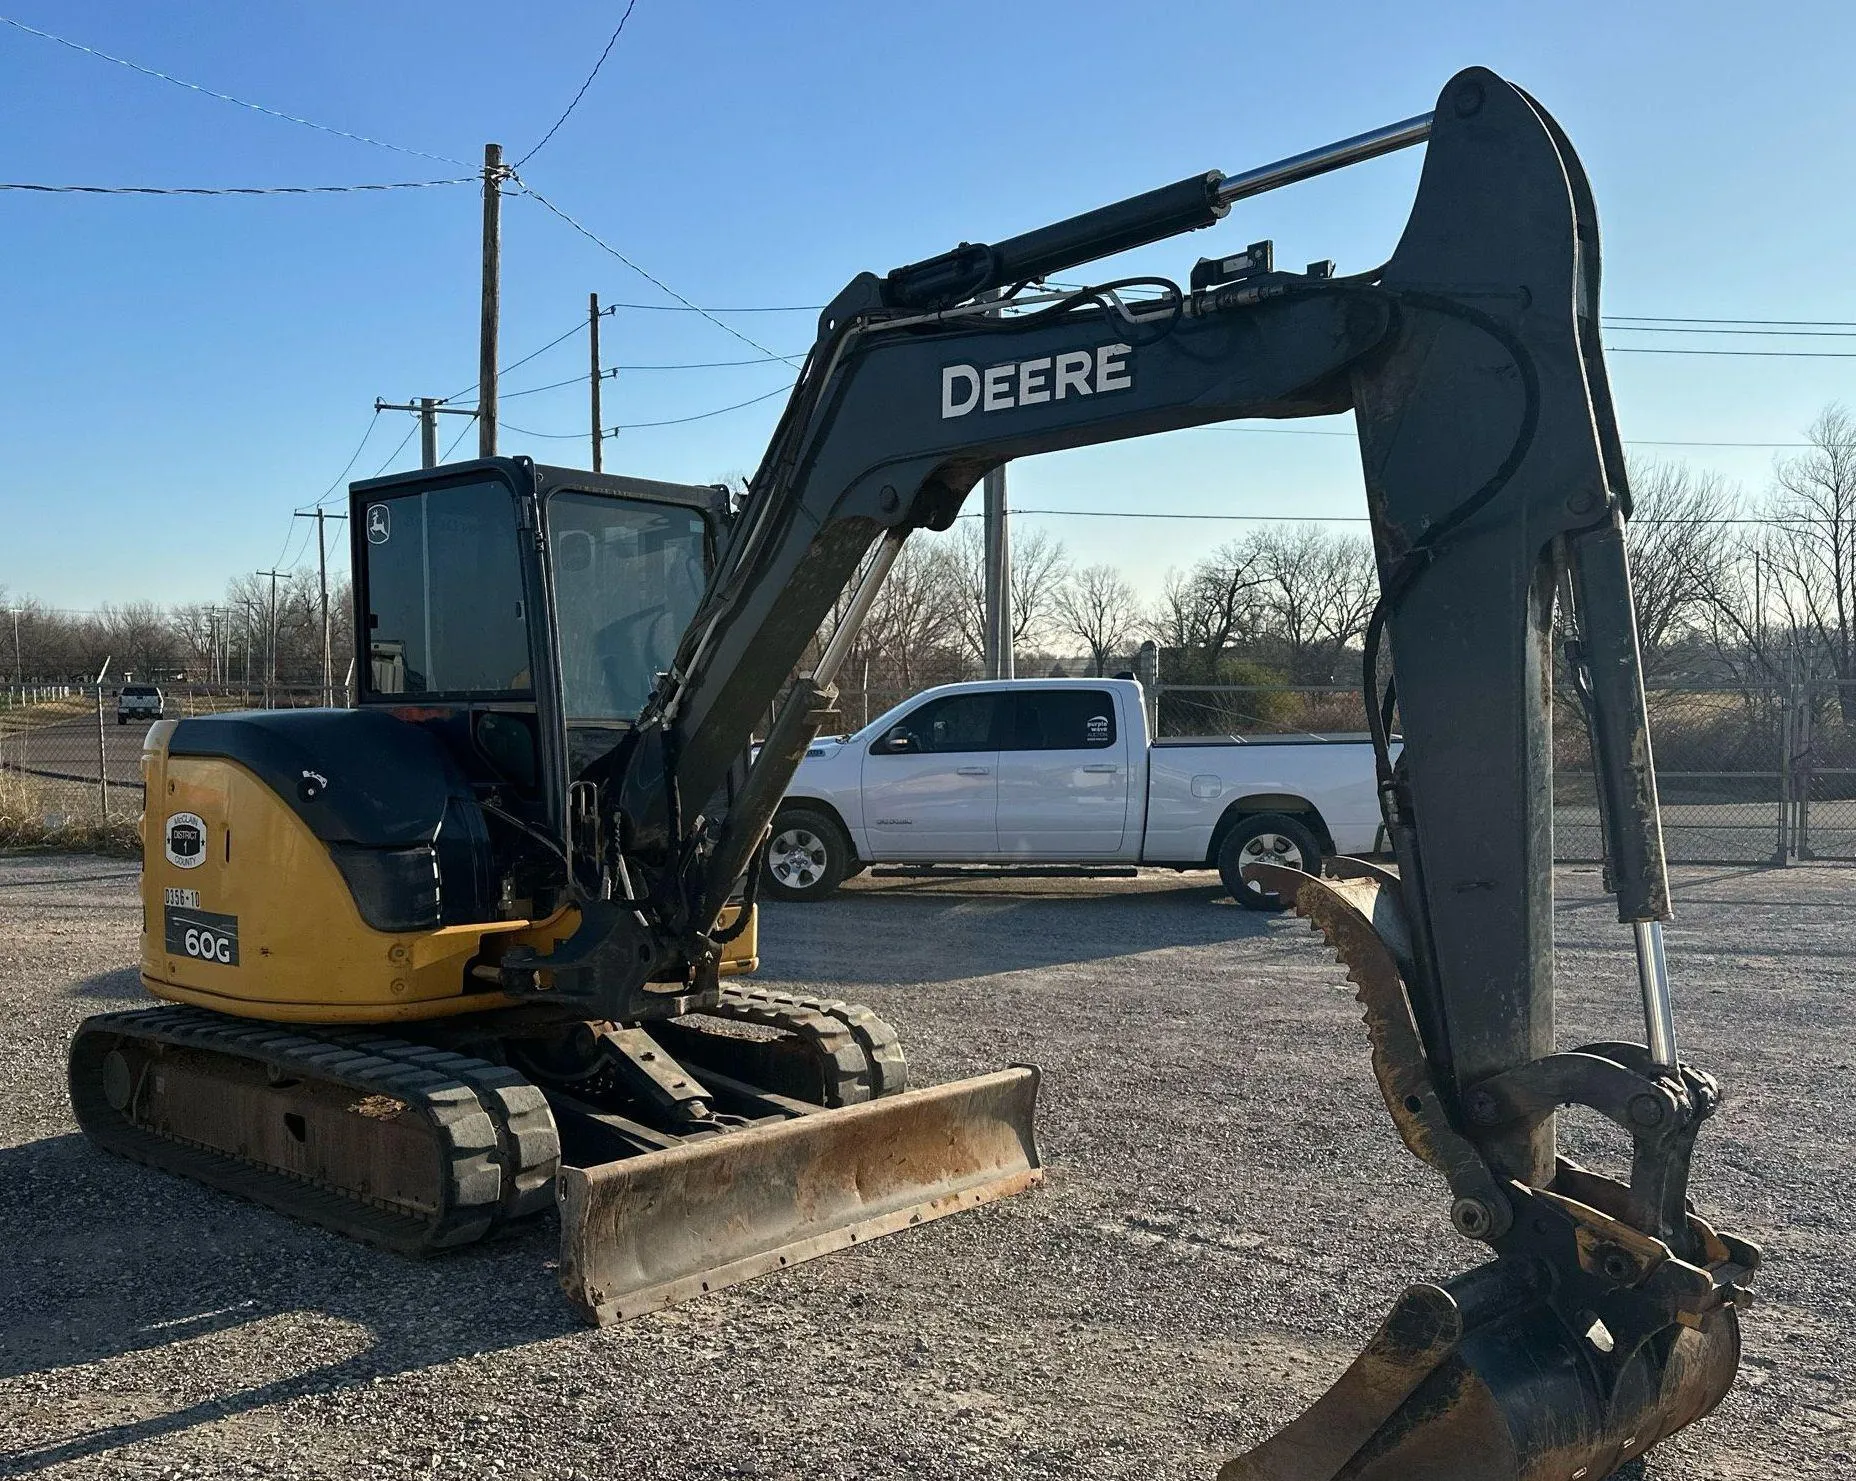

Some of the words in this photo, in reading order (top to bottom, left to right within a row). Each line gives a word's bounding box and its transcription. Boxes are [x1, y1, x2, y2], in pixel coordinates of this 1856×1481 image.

[942, 343, 1132, 419] DEERE
[173, 831, 198, 840] DISTRICT
[183, 841, 188, 854] 1
[174, 856, 197, 867] COUNTY
[185, 929, 230, 963] 60G
